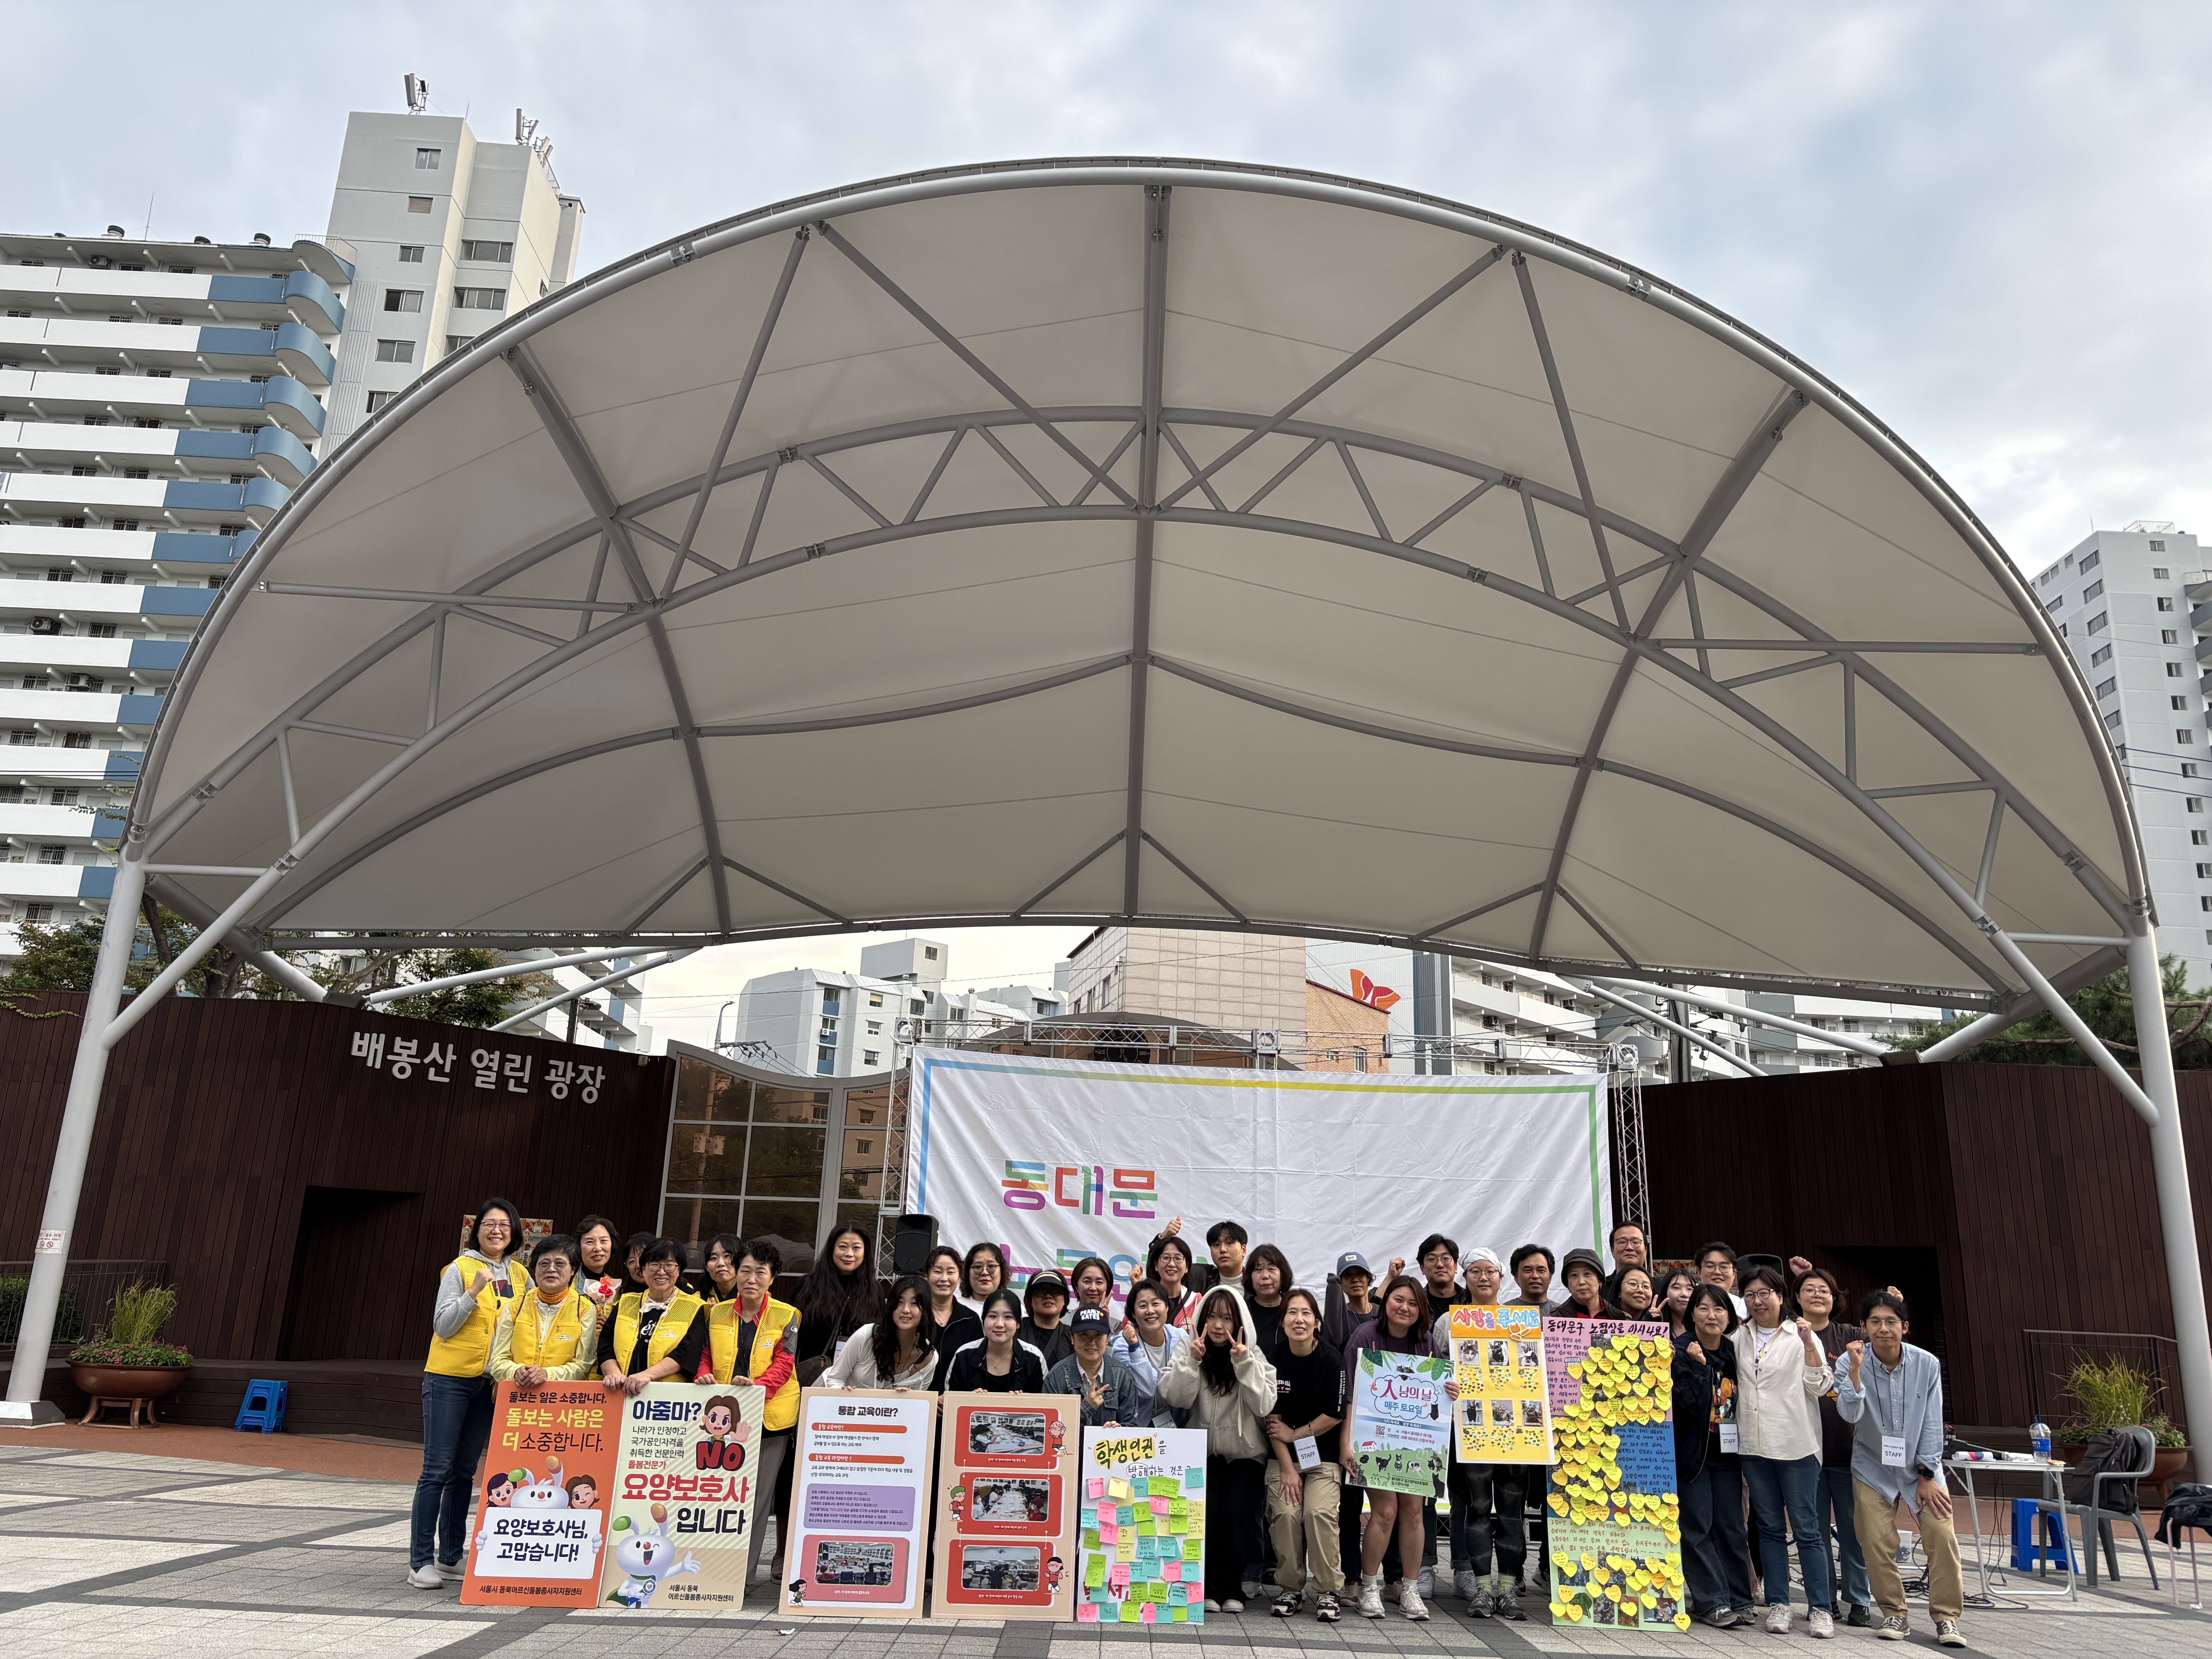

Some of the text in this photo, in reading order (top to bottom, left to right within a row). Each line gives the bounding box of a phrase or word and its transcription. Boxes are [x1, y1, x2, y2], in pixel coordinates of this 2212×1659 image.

[350, 1031, 606, 1104] 배봉산 열린 광장
[1001, 1160, 1158, 1219] 동대문
[1453, 1307, 1540, 1329] 사랑을 주세요
[1547, 1319, 1668, 1338] 동대문구 노점상을 아시나요!
[509, 1392, 607, 1405] 돌보는 일은 소중합니다.
[1421, 1388, 1432, 1401] 날
[632, 1400, 702, 1422] 아줌마?
[838, 1406, 898, 1417] 통합 교육이란?
[1384, 1401, 1422, 1415] 매주 토요일
[506, 1408, 604, 1428] 돌보는 사람은
[632, 1425, 687, 1436] 나라가 인정하고
[502, 1432, 604, 1452] 더 소중합니다.
[630, 1437, 684, 1447] 국가공인자격을
[629, 1448, 684, 1459] 취득한 전문인력
[696, 1440, 745, 1471] NO
[1301, 1451, 1316, 1459] STAFF
[628, 1460, 667, 1470] 돌봄전문가
[1128, 1464, 1183, 1478] 방해하는 것은
[622, 1473, 750, 1504] 요양보호사
[493, 1519, 588, 1539] 요양보호사님,
[677, 1507, 746, 1535] 입니다
[496, 1542, 579, 1562] 고맙습니다!
[479, 1585, 498, 1593] 서울시
